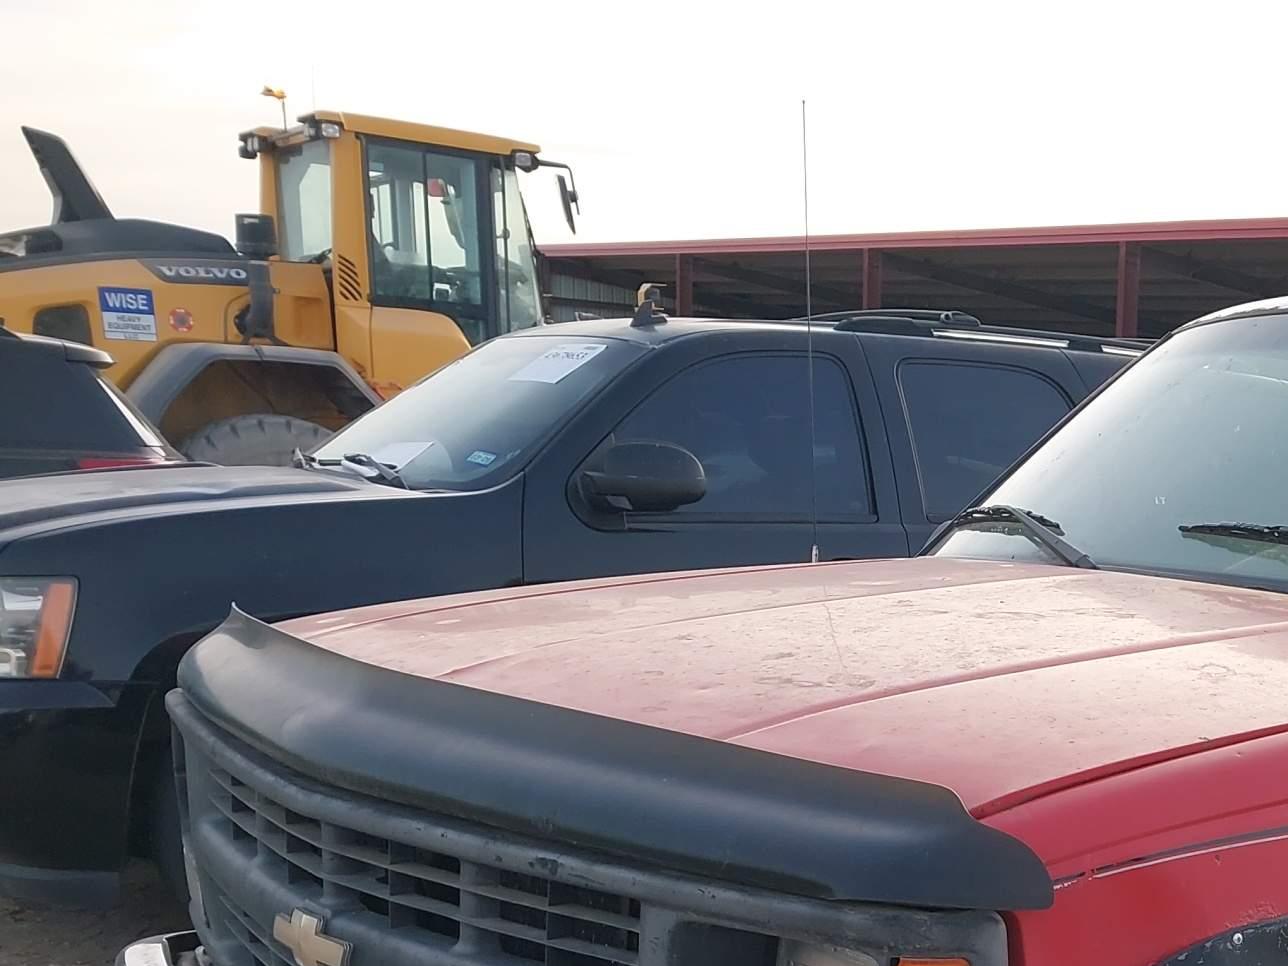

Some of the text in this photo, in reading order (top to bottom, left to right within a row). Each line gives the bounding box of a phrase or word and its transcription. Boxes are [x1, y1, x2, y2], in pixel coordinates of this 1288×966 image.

[158, 266, 247, 279] VOLVO
[104, 292, 149, 310] WISE
[107, 322, 151, 331] EQUIPMENT
